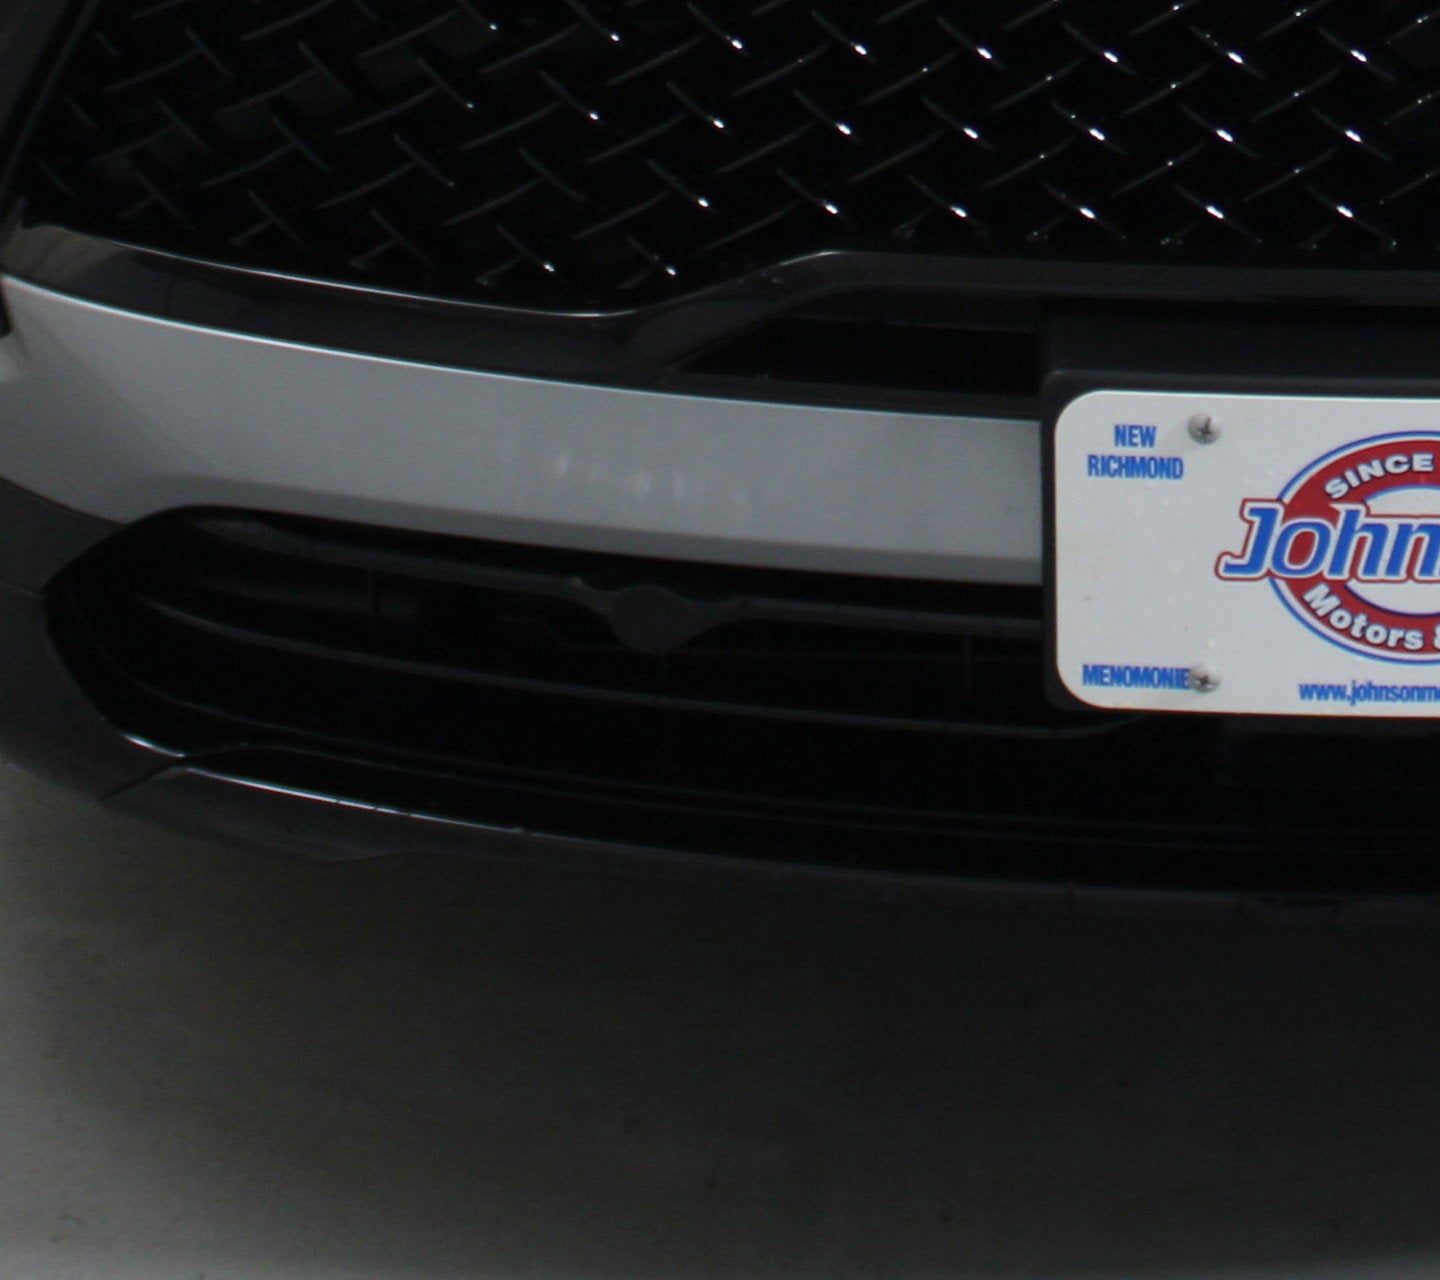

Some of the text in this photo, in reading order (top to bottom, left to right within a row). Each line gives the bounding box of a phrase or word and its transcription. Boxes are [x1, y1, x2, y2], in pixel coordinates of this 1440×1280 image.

[1114, 424, 1157, 448] NEW
[1087, 454, 1184, 479] RICHMOND
[1324, 452, 1435, 500] SINCE
[1303, 582, 1425, 651] Motors
[1082, 664, 1191, 690] MENOMONIE
